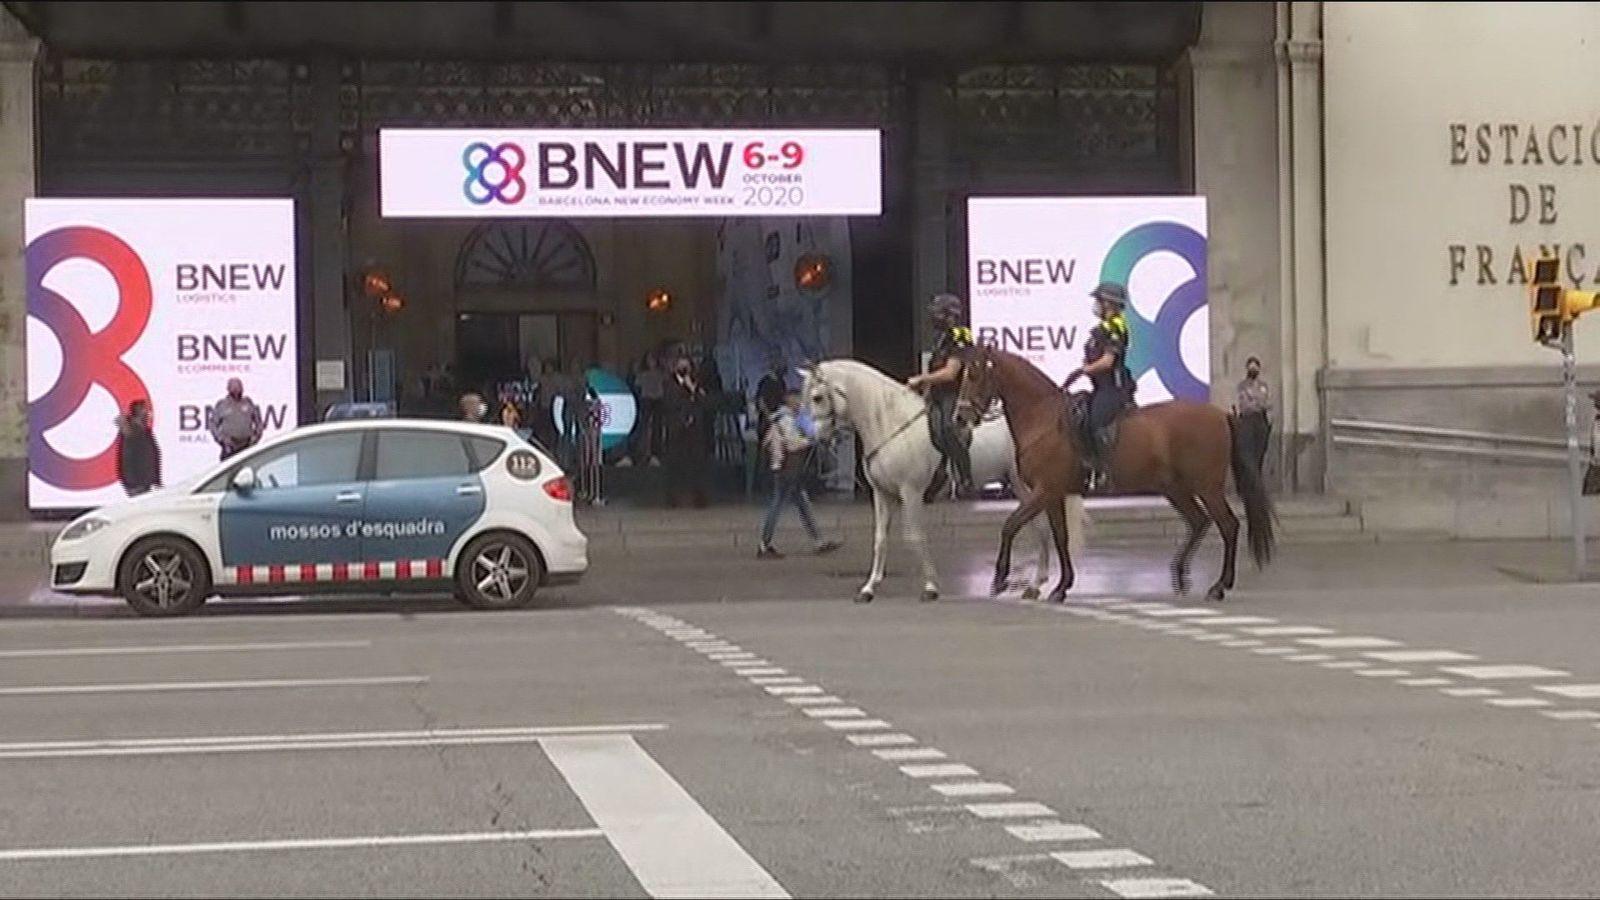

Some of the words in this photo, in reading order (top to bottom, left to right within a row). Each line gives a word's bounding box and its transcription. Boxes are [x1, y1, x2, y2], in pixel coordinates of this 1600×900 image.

[538, 141, 734, 190] BNEW
[742, 141, 804, 169] 6-9
[742, 174, 803, 184] OCTOBER
[538, 195, 611, 206] BARCELONA
[614, 195, 639, 206] NEW
[643, 195, 699, 206] ECONOMY
[704, 195, 734, 206] WEEK
[743, 187, 804, 207] 2020
[1509, 183, 1558, 225] DE
[176, 264, 286, 291] BNEW
[976, 258, 1076, 285] BNEW
[176, 293, 236, 304] LOGISTICS
[177, 334, 287, 361] BNEW
[979, 325, 1077, 351] BNEW
[177, 364, 251, 374] ECOMMERCE
[179, 404, 287, 431] BW
[512, 455, 536, 471] 112
[270, 524, 341, 541] mossos
[346, 518, 445, 540] d'esquadra
